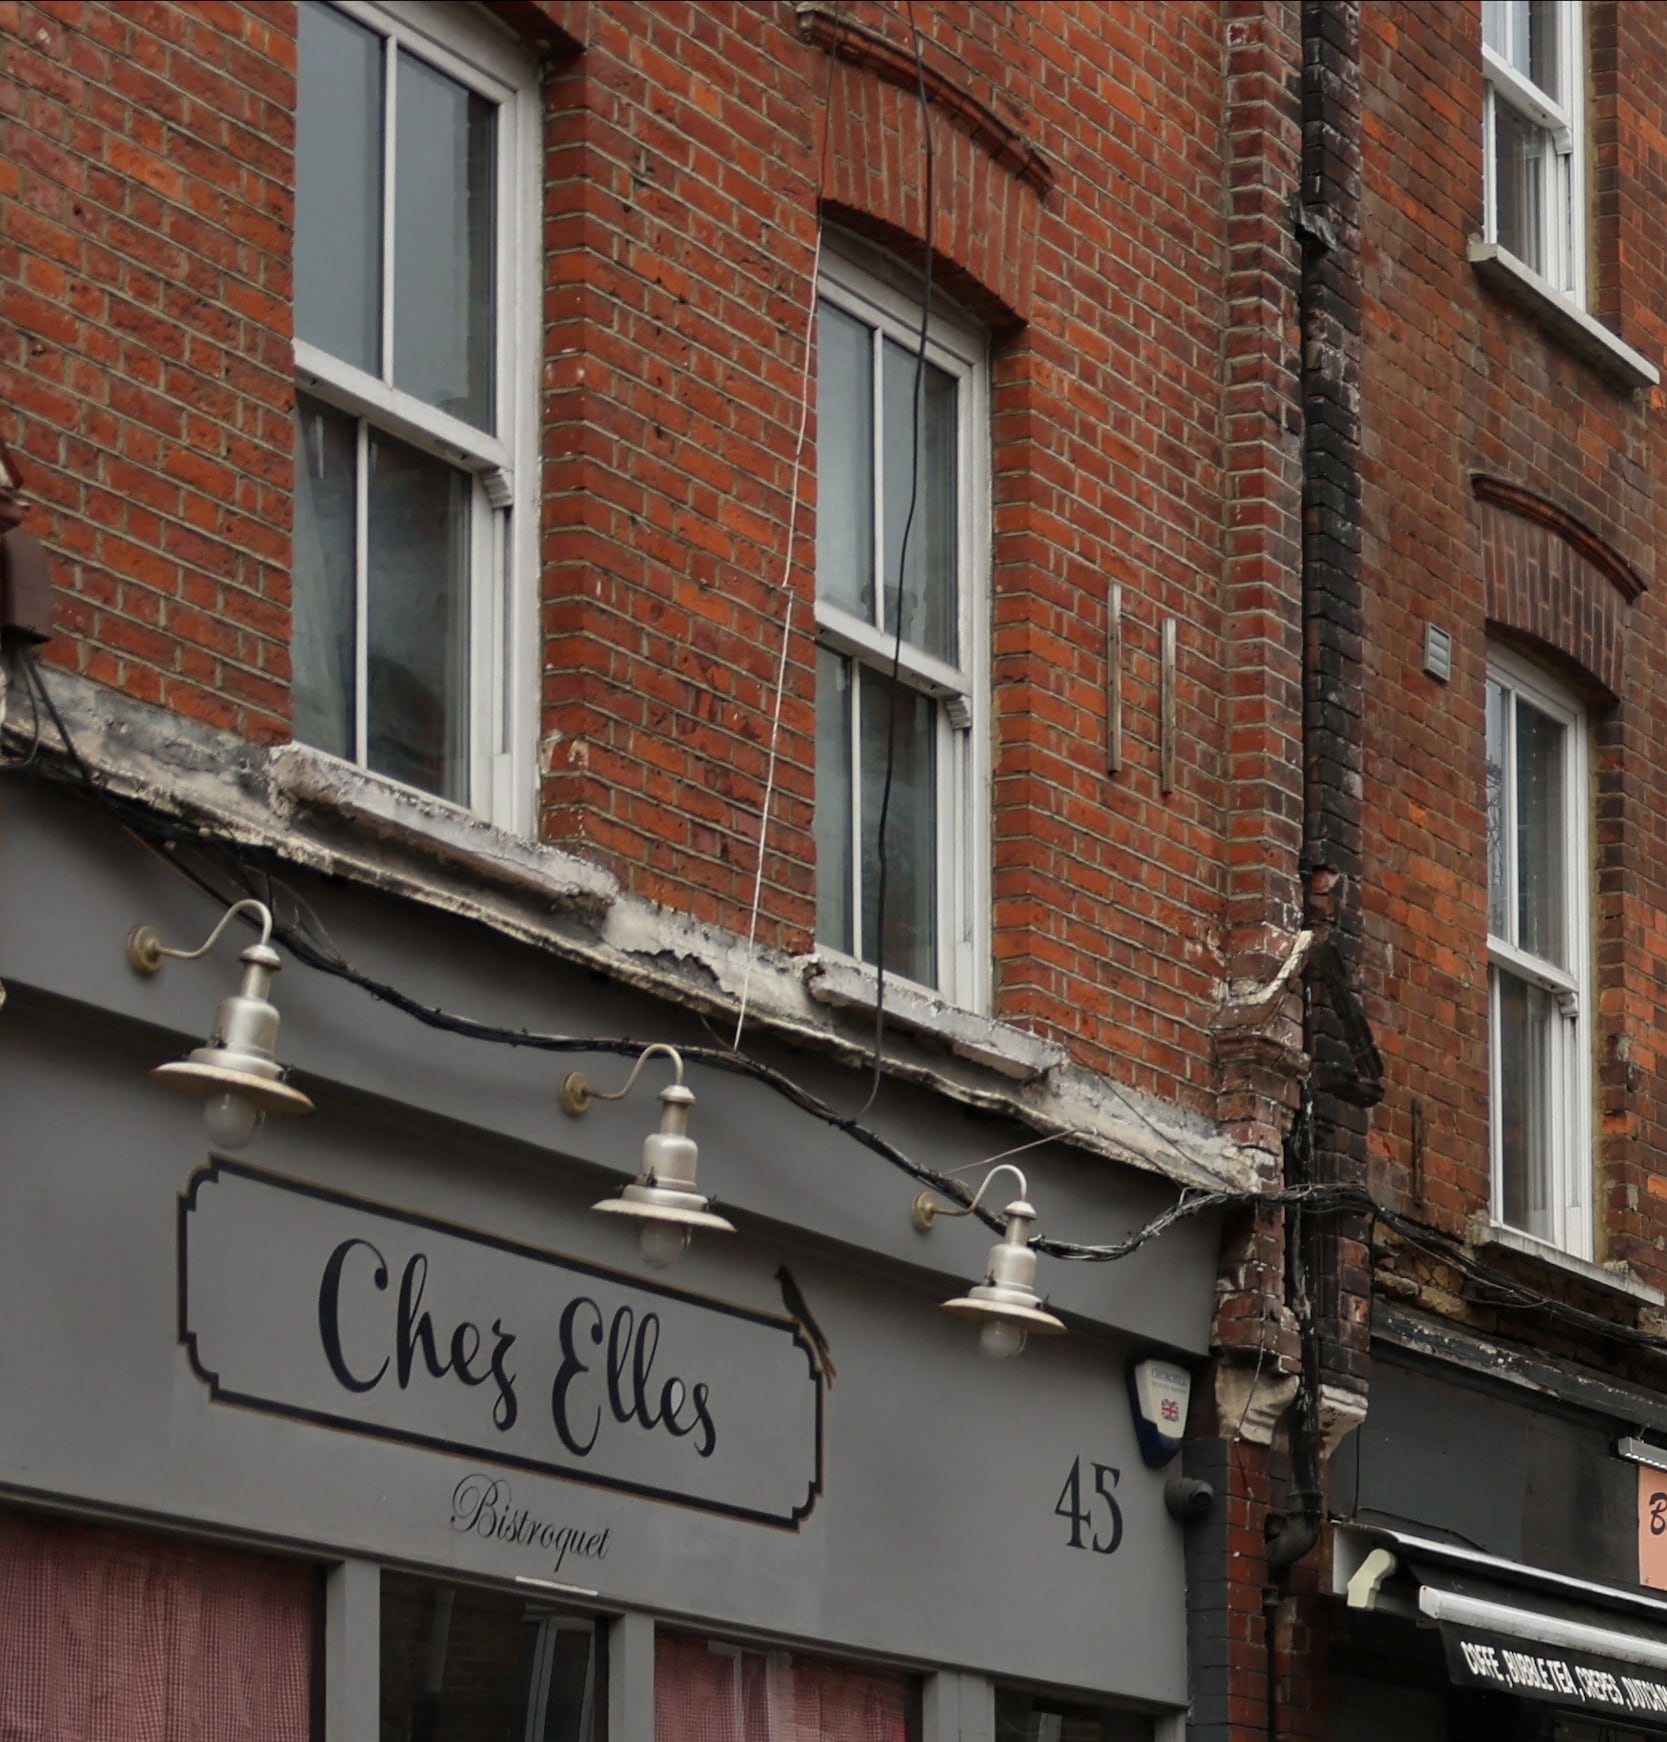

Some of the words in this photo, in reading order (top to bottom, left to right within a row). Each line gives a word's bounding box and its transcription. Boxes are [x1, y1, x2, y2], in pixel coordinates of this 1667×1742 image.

[318, 1238, 517, 1431] Chez
[551, 1297, 716, 1458] Elles
[450, 1473, 610, 1572] Bistroquet
[1054, 1453, 1123, 1554] 45
